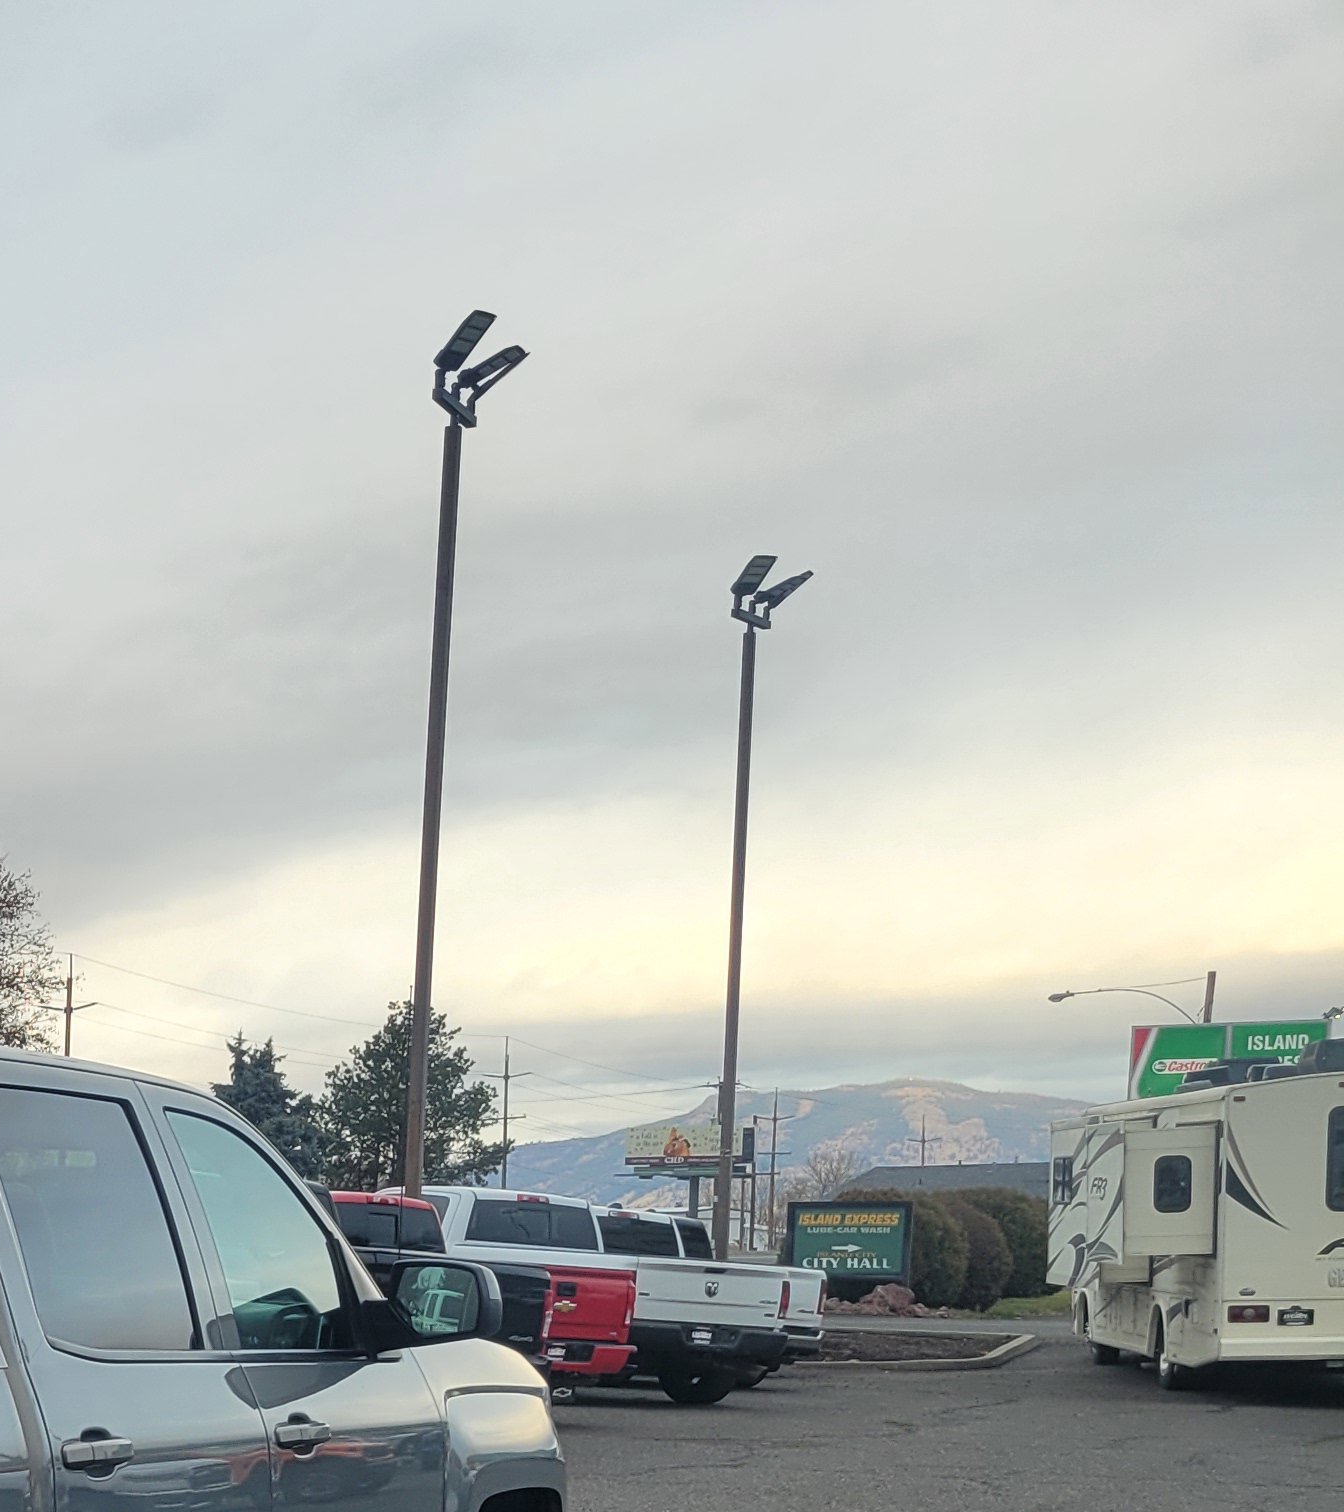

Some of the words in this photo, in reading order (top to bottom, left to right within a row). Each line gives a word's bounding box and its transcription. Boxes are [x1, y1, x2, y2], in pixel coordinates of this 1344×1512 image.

[1247, 1034, 1310, 1051] ISLAND
[1168, 1060, 1208, 1073] Castro
[798, 1213, 842, 1226] ISLAND
[844, 1213, 900, 1226] EXPRESS
[860, 1226, 891, 1234] WASH
[802, 1257, 840, 1269] CITY
[846, 1257, 892, 1269] HALL
